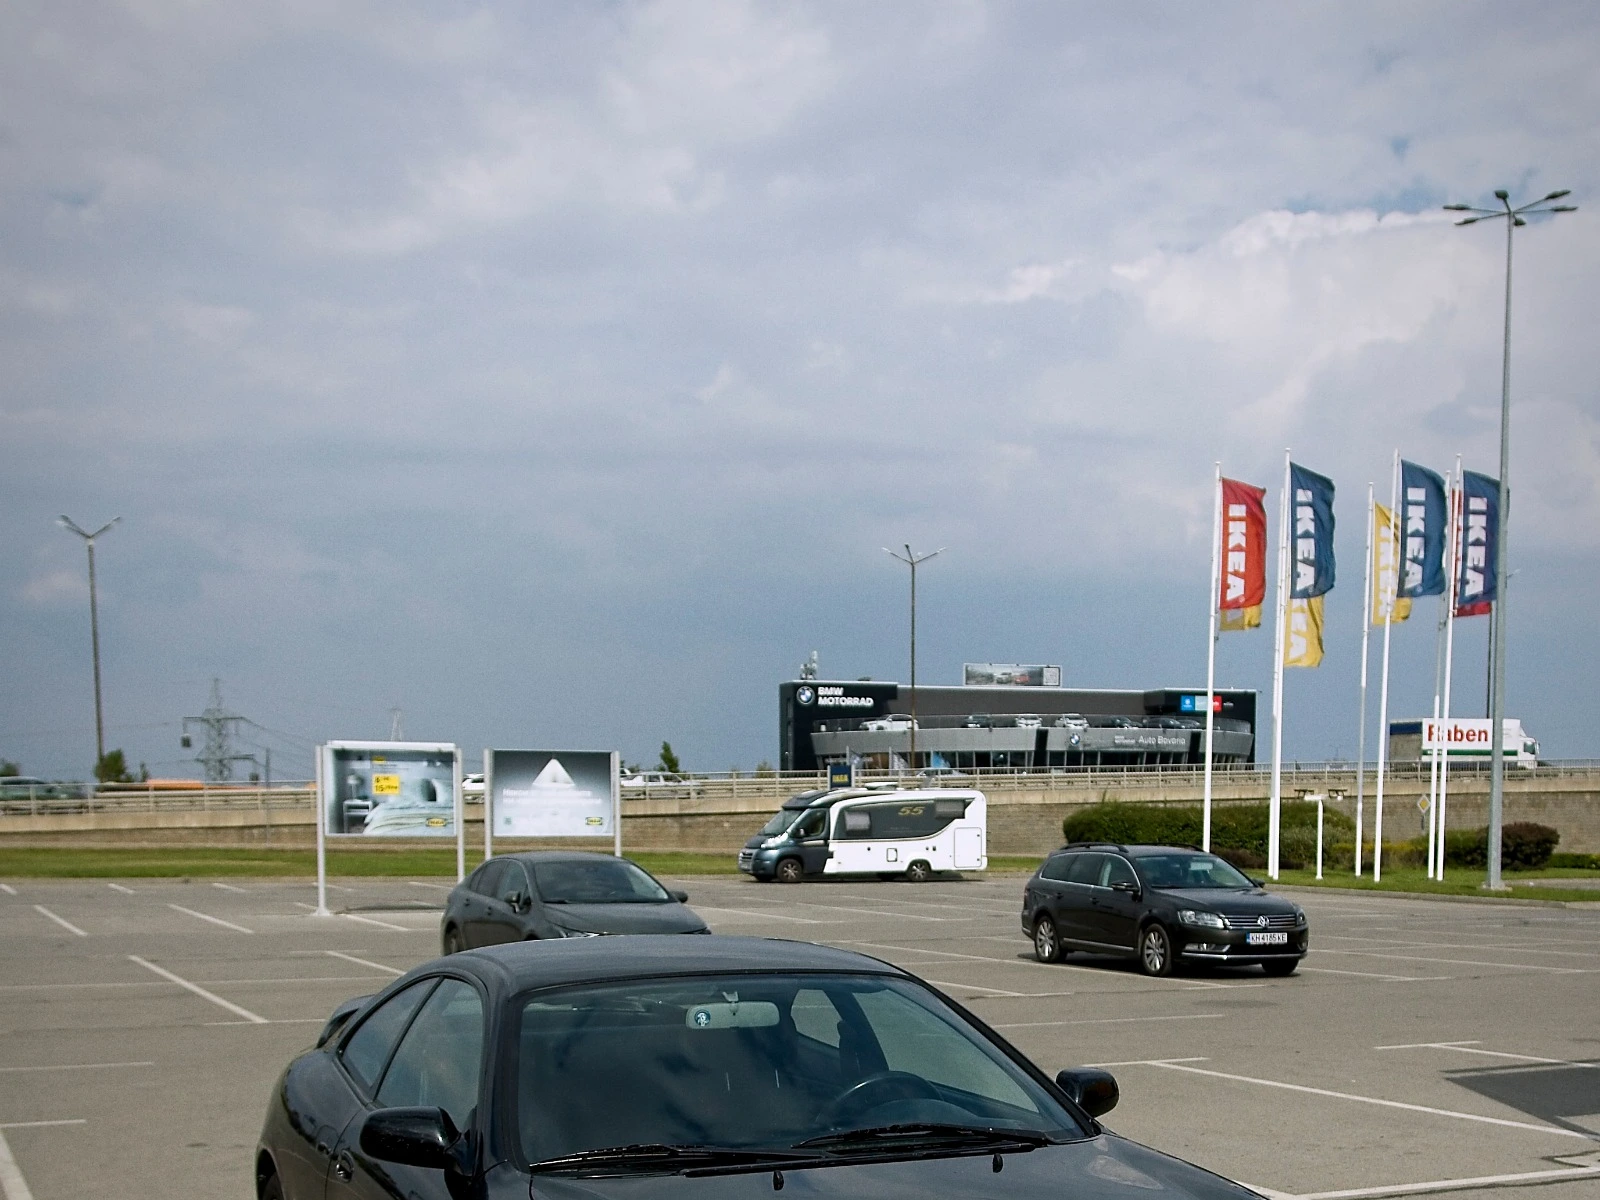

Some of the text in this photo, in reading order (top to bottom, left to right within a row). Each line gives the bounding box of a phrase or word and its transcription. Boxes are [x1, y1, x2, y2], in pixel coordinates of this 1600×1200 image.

[1226, 504, 1247, 602] IKEA
[1296, 488, 1315, 591] IKEA
[1404, 487, 1426, 590] IKEA
[1465, 496, 1488, 597] IKEA
[817, 686, 844, 696] BMW
[817, 696, 874, 707] MOTORRAD
[1138, 735, 1157, 744] Auto
